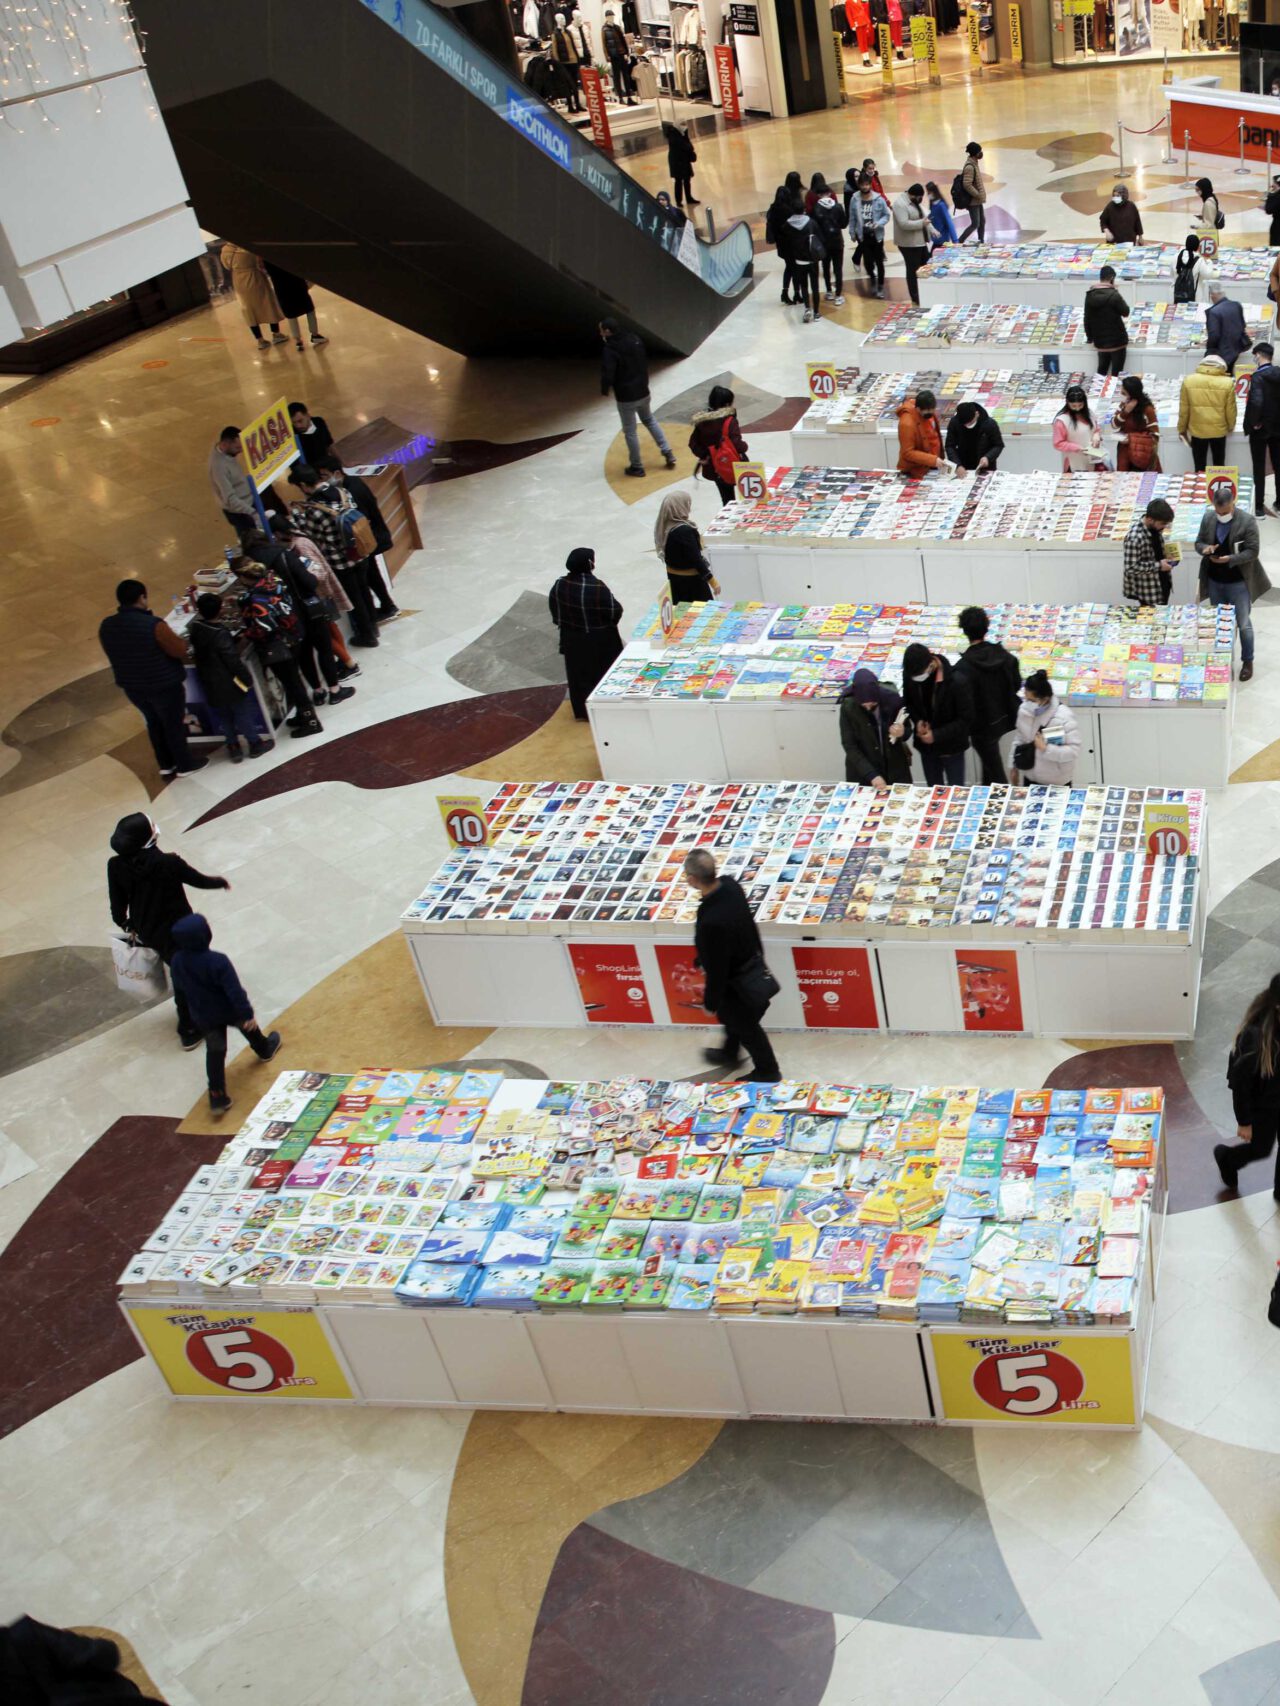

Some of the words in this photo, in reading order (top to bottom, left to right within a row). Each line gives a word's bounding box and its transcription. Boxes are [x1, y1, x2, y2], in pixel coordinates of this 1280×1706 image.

[432, 33, 469, 80] FARKLI
[470, 66, 497, 104] SPOR
[509, 98, 569, 164] DECATHLON
[1199, 239, 1215, 254] 15
[812, 375, 833, 394] 20
[245, 409, 292, 469] KASA
[740, 476, 763, 498] 15
[662, 601, 673, 621] 10
[448, 815, 482, 843] 10
[1156, 831, 1180, 855] 10
[167, 1315, 206, 1326] Tüm
[184, 1316, 254, 1332] Kitaplar
[967, 1337, 1008, 1349] Tüm
[981, 1339, 1060, 1356] Kitaplar
[202, 1330, 275, 1390] 5
[279, 1376, 316, 1387] Lira
[996, 1353, 1059, 1414] 5
[1061, 1400, 1100, 1411] Lira
